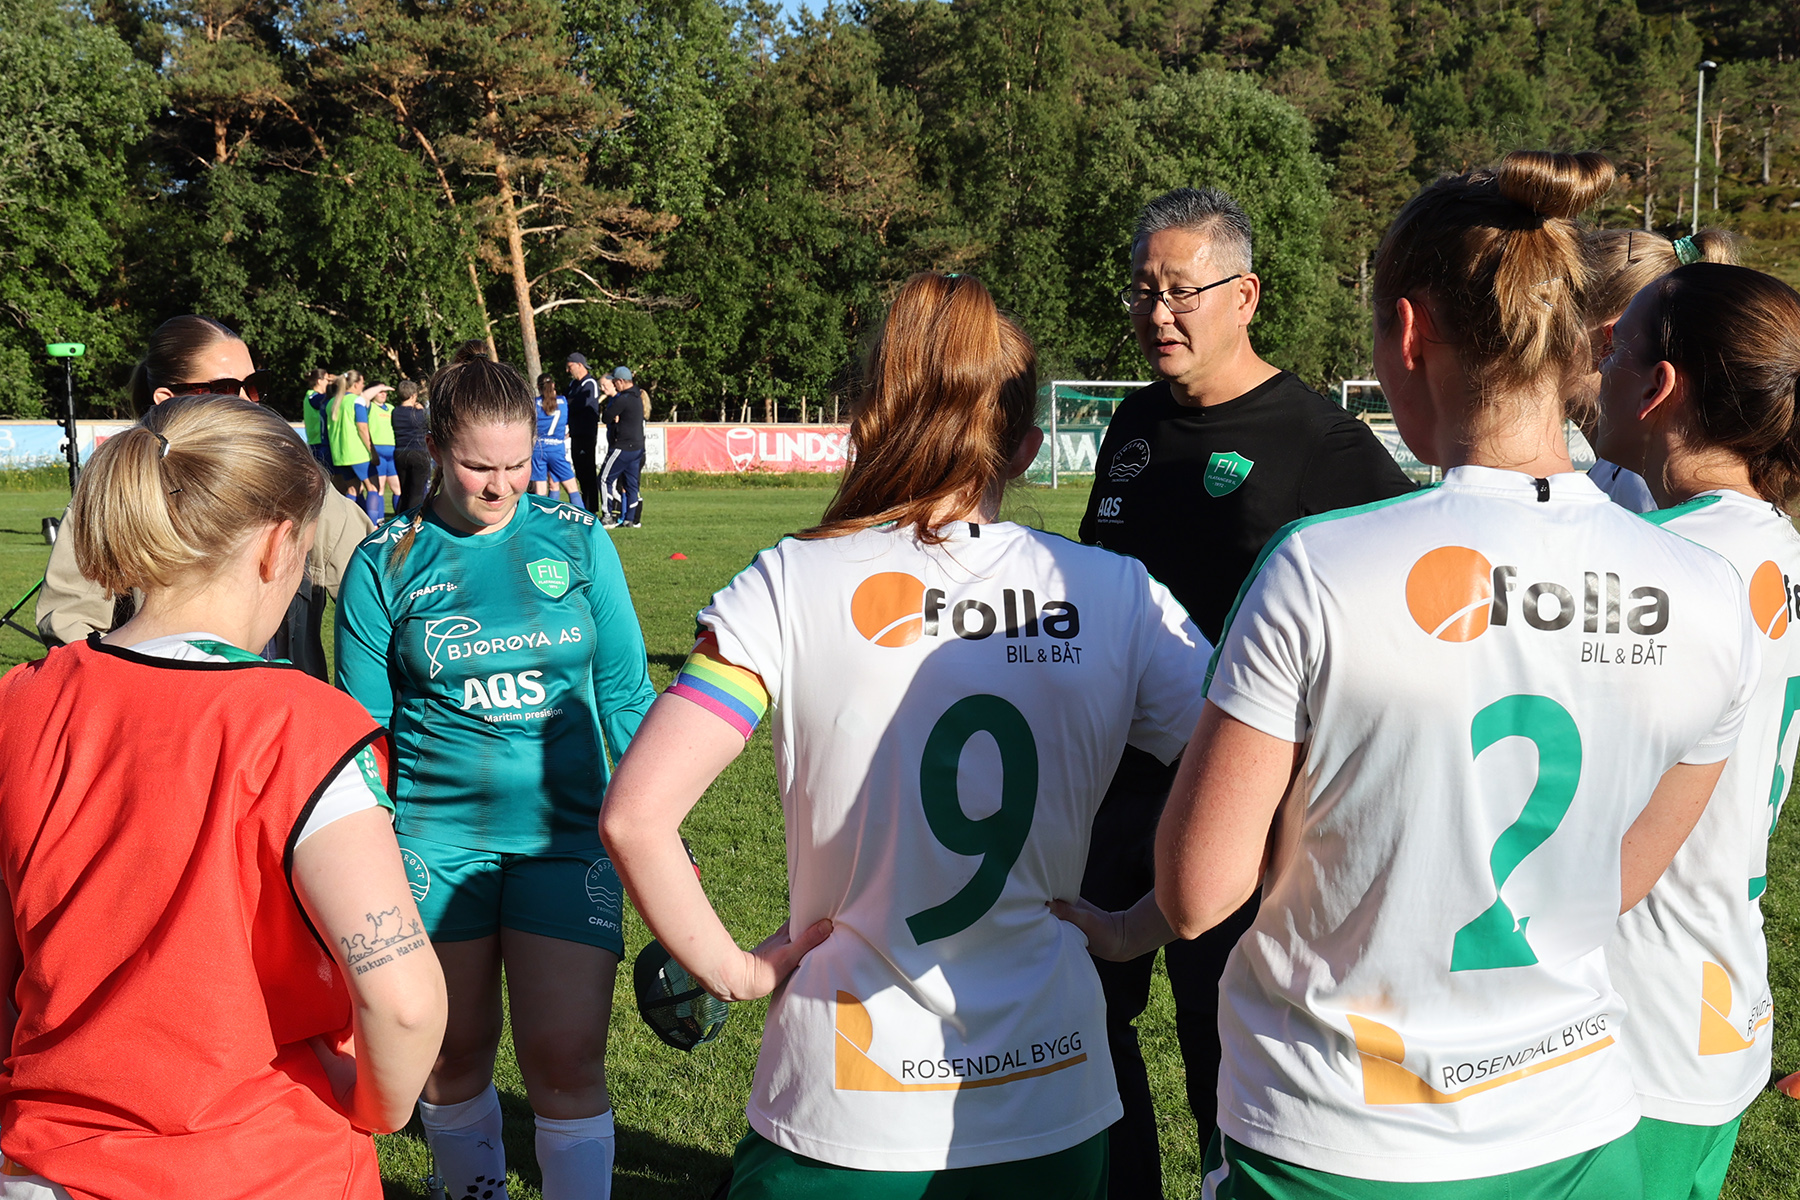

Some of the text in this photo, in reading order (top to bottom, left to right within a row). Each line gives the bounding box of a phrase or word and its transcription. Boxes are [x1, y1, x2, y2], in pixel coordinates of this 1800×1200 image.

[547, 410, 561, 436] 7
[1214, 459, 1238, 477] FIL
[558, 509, 595, 526] NTE
[1097, 497, 1122, 517] AQS
[537, 565, 563, 578] FIL
[410, 584, 446, 600] CRAFT
[1490, 565, 1669, 635] folla
[924, 588, 1081, 640] folla
[447, 627, 582, 660] BJØRØYA AS
[1006, 641, 1082, 664] BIL & BÅT
[1581, 639, 1667, 665] BIL & BÅT
[460, 670, 546, 709] AQS
[484, 708, 563, 722] Maritim presisjon
[905, 694, 1038, 945] 9
[1449, 694, 1582, 972] 2
[588, 916, 617, 931] CRAFT
[356, 939, 425, 975] Hakuna Matata
[902, 1032, 1082, 1079] ROSENDAL BYGG
[1442, 1013, 1609, 1088] ROSENDAL BYGG
